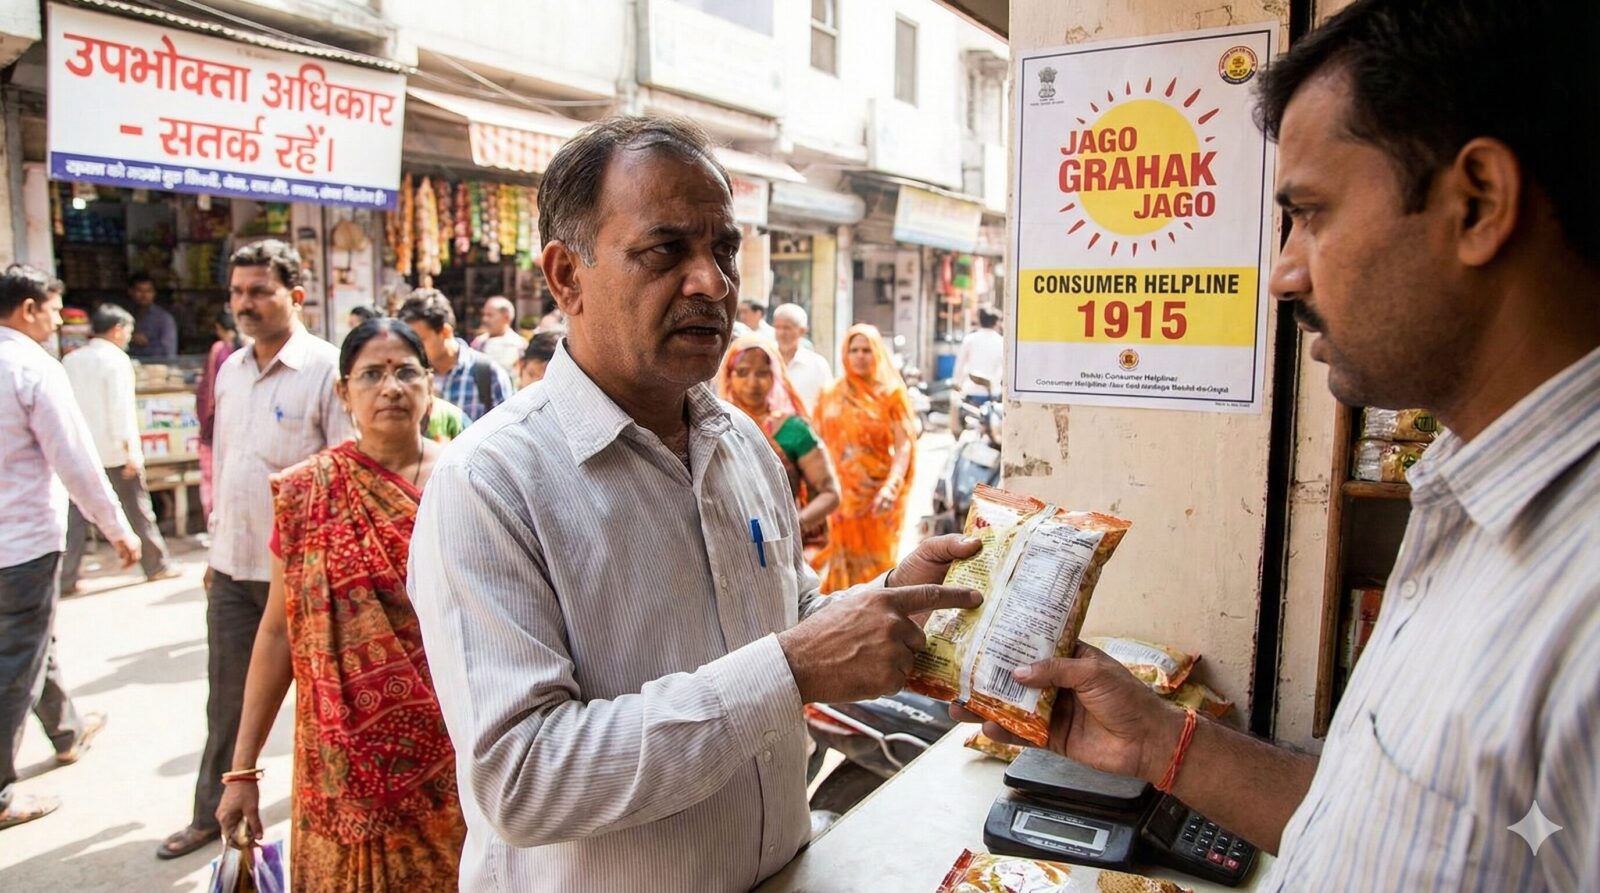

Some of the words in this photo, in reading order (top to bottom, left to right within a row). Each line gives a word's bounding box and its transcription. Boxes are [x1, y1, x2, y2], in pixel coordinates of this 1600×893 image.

[63, 32, 251, 102] उपभोक्ता
[262, 63, 397, 126] अधिकार
[158, 116, 266, 162] सतर्क
[1060, 126, 1138, 156] JAGO
[1058, 151, 1218, 194] GRAHAK
[1133, 191, 1216, 220] JAGO
[1033, 274, 1137, 294] CONSUMER
[1144, 274, 1240, 294] HELPLINE
[1077, 300, 1188, 340] 1915
